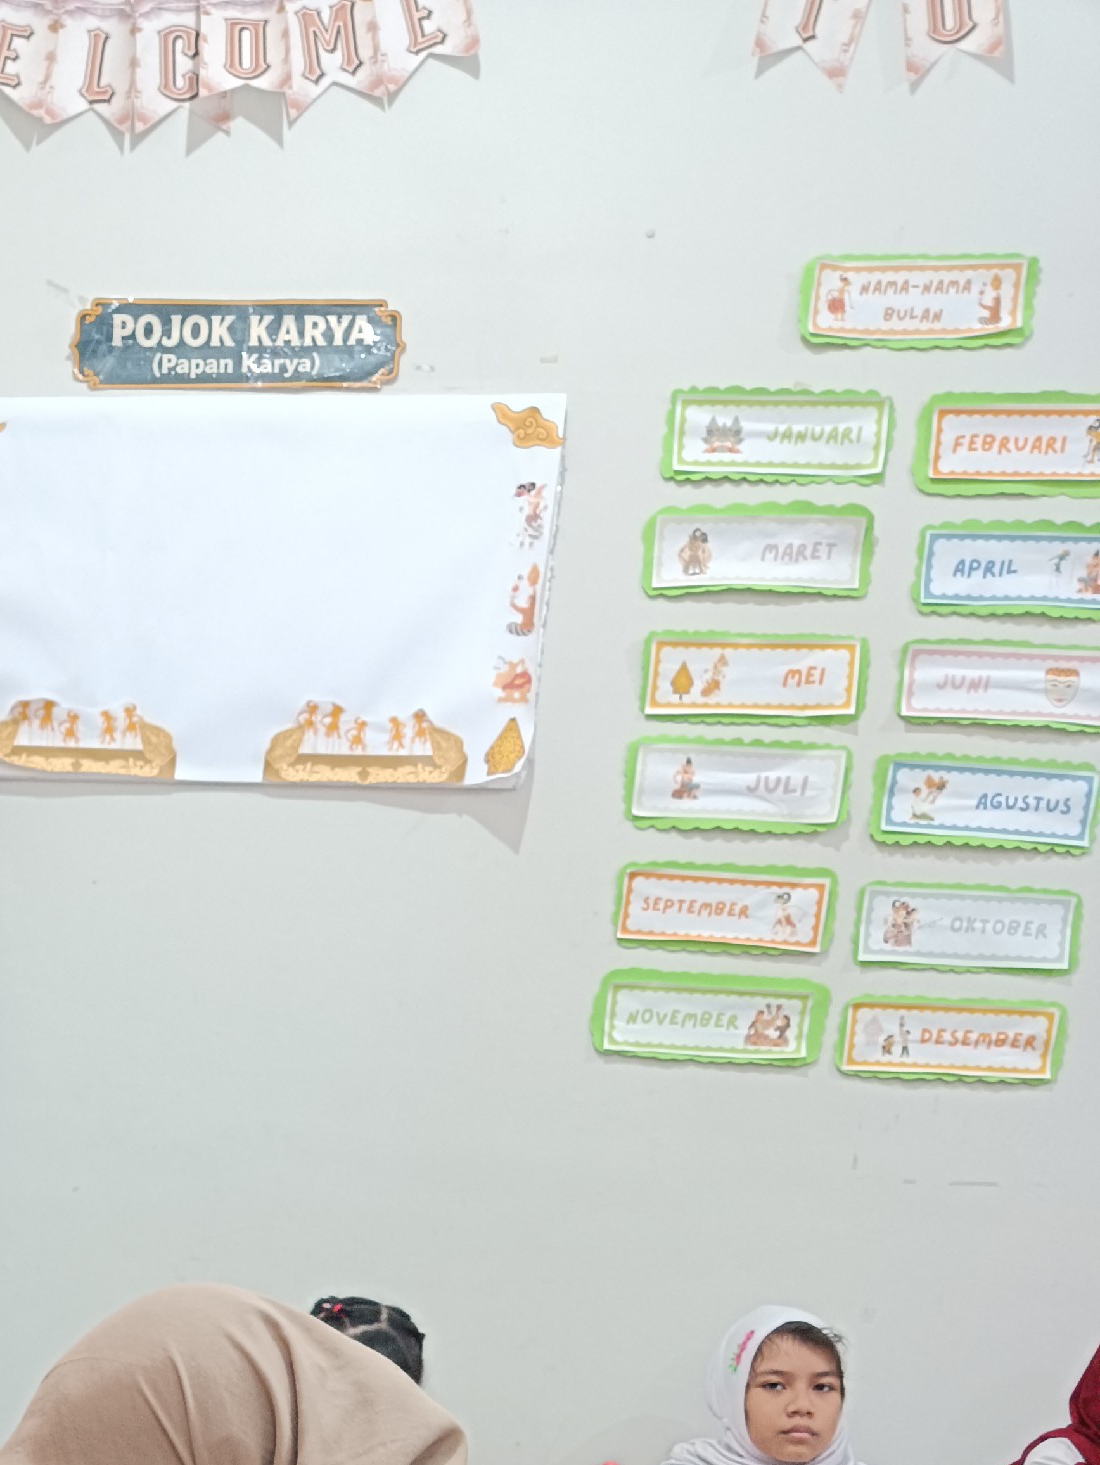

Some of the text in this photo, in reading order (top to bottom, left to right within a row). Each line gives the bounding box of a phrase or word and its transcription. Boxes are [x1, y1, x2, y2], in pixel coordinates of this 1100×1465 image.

[859, 277, 972, 297] NAMA-NAMA
[882, 306, 943, 325] BULAN
[111, 313, 375, 348] POJOK KARYA
[152, 351, 320, 378] (Papan Karya)
[766, 425, 862, 446] JANUARI
[952, 434, 1067, 455] FEBRUARI
[760, 541, 838, 563] MARET
[952, 558, 1019, 579] APRIL
[782, 667, 825, 688] MEI
[936, 673, 992, 694] JUNI
[745, 774, 810, 797] JULI
[974, 793, 1073, 816] AGUSTUS
[640, 896, 751, 921] SEPTEMBER
[948, 917, 1049, 940] OKTOBER
[625, 1007, 740, 1032] NOVEMBER
[919, 1027, 1038, 1051] DESEMBER
